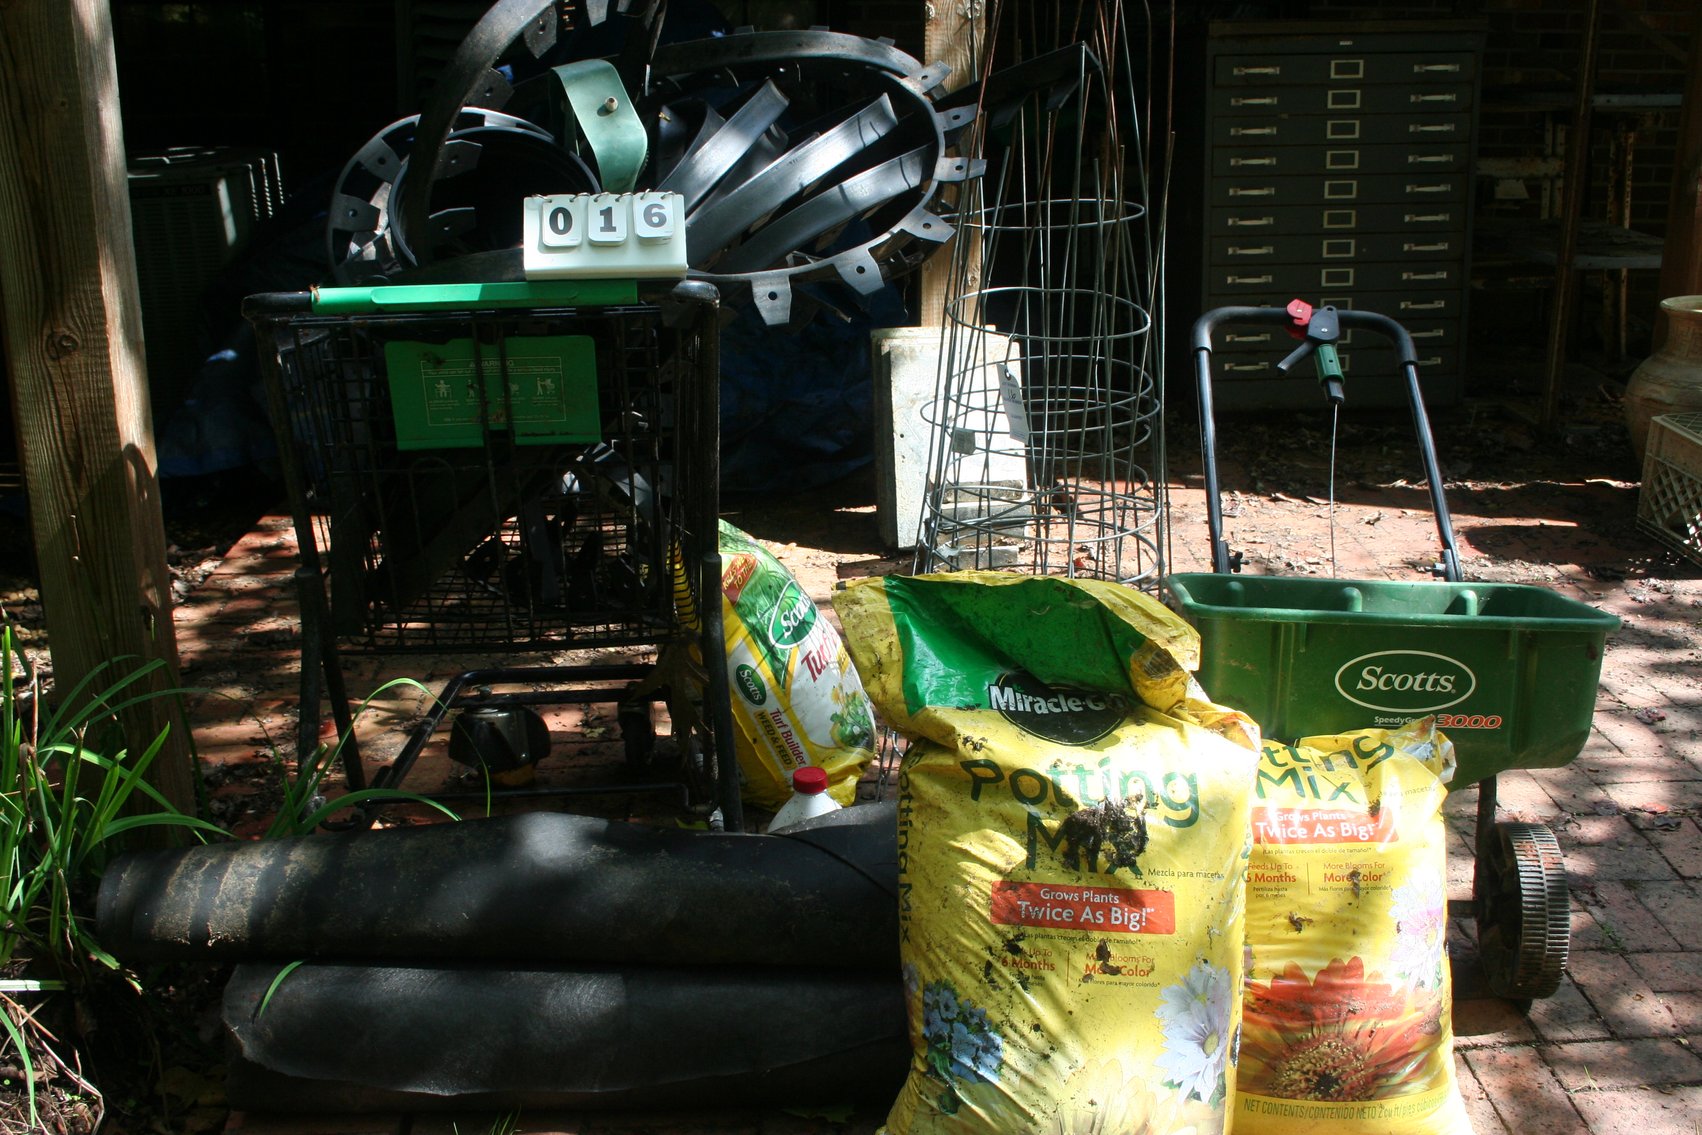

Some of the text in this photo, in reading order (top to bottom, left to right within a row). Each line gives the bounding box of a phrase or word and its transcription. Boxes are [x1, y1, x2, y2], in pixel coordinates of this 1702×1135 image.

[739, 668, 763, 701] Scotts
[1355, 665, 1456, 693] Scotts
[988, 684, 1130, 716] Miracle-G
[1435, 713, 1503, 729] 3000
[757, 711, 793, 766] WEED & FEED
[769, 708, 807, 766] Turf Builder
[1261, 735, 1395, 775] ttng
[960, 755, 1201, 829] Potting
[1255, 766, 1360, 805] Mix
[1276, 810, 1346, 822] Grows Plants
[1255, 821, 1308, 839] Twice
[1313, 822, 1336, 838] As
[1147, 867, 1176, 877] Mezcla
[1177, 870, 1194, 880] para
[1247, 862, 1293, 873] Feeds Up To
[1345, 861, 1374, 870] Blooms
[1374, 861, 1385, 869] For
[1254, 872, 1297, 883] Months
[1323, 871, 1383, 883] More olor
[1040, 888, 1120, 904] Grows Plants
[899, 882, 913, 945] Mix
[1017, 900, 1075, 922] Twice
[1080, 905, 1104, 924] As
[1034, 932, 1057, 941] plantas
[1085, 935, 1101, 943] dobl
[1043, 948, 1053, 957] To
[1110, 953, 1141, 964] Blooms
[1142, 955, 1155, 964] For
[1001, 956, 1057, 972] 6 Months
[1120, 964, 1151, 978] Color
[1244, 1098, 1261, 1113] NET
[1262, 1101, 1355, 1120] CONTENTS/CONTENIDO
[1356, 1107, 1377, 1120] NETO
[1384, 1109, 1392, 1119] cu
